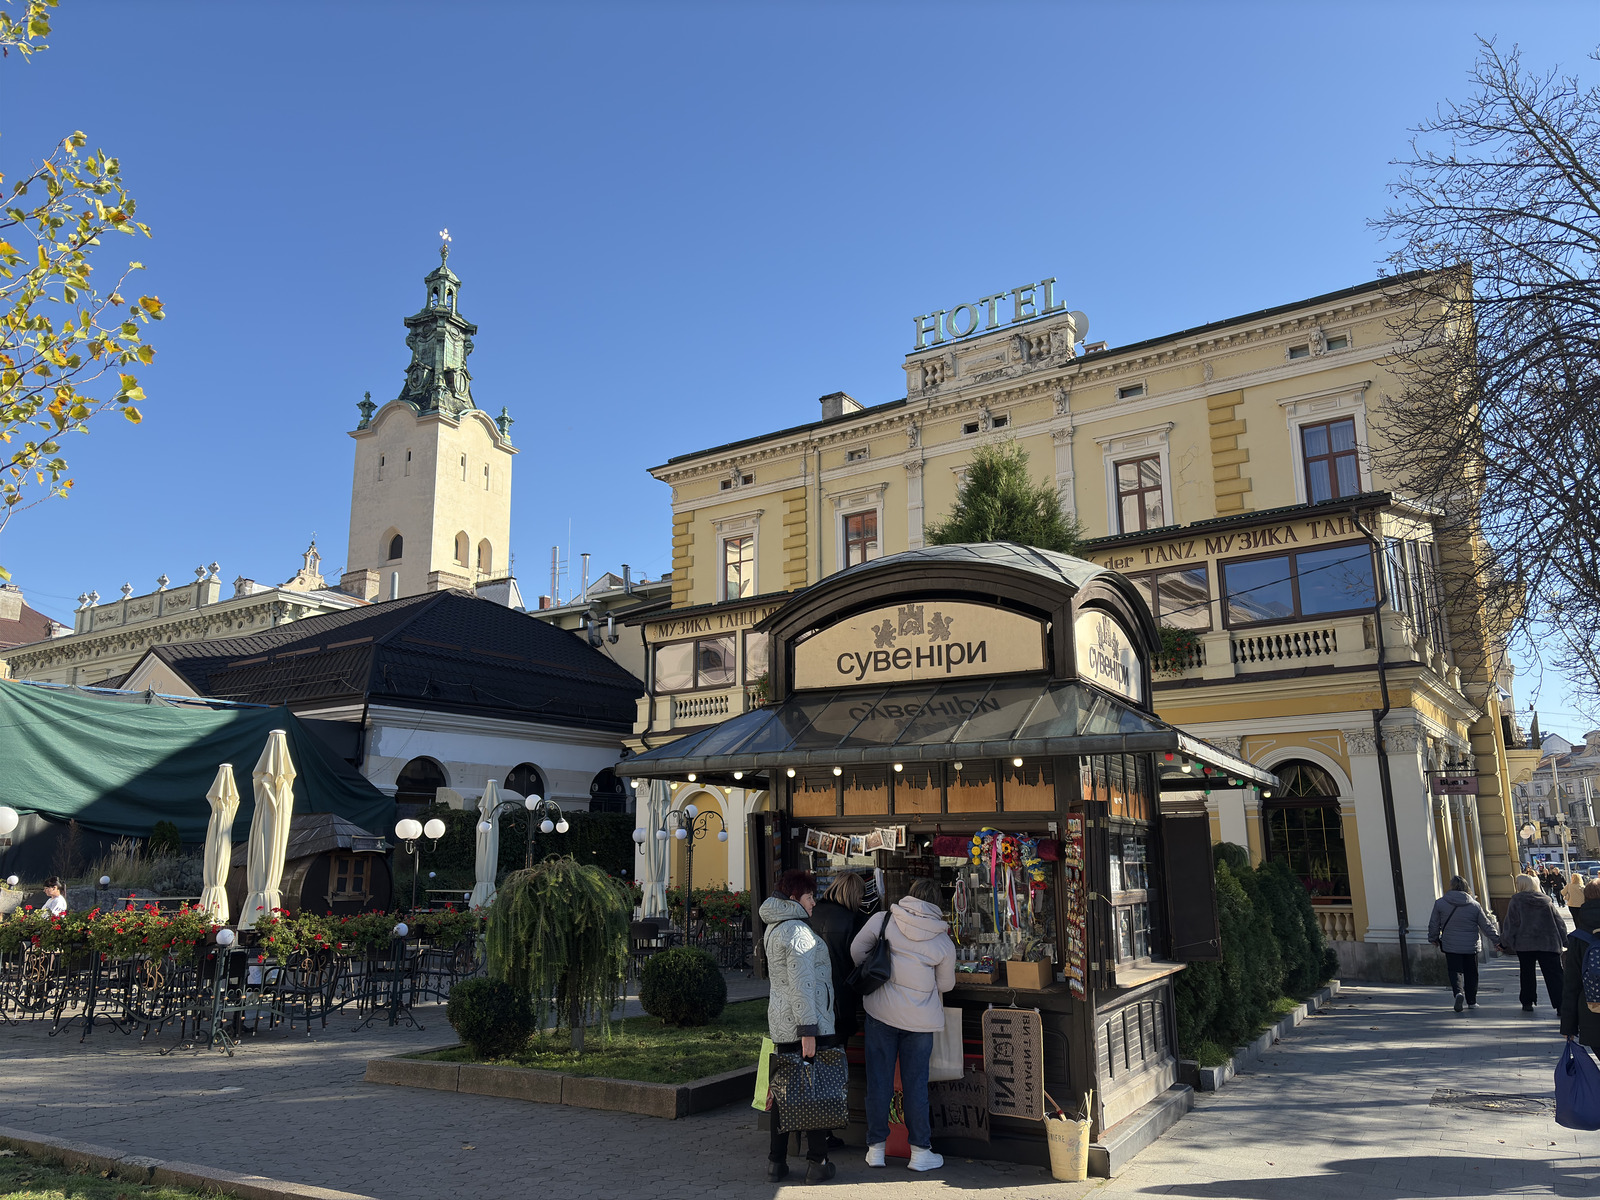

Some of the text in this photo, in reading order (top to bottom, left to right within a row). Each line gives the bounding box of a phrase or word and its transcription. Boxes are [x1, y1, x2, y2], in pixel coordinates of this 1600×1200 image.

[913, 276, 1067, 350] HOTEL
[1103, 556, 1134, 570] der
[1140, 540, 1197, 565] TANZ
[1204, 525, 1299, 555] МУЗИКА
[658, 617, 712, 638] МУЗИКА
[717, 607, 757, 629] ТАНЦІ
[837, 640, 987, 681] сувеніри
[1089, 646, 1130, 690] сувеніри
[1022, 1014, 1034, 1115] ВИТИРАЙТЕ
